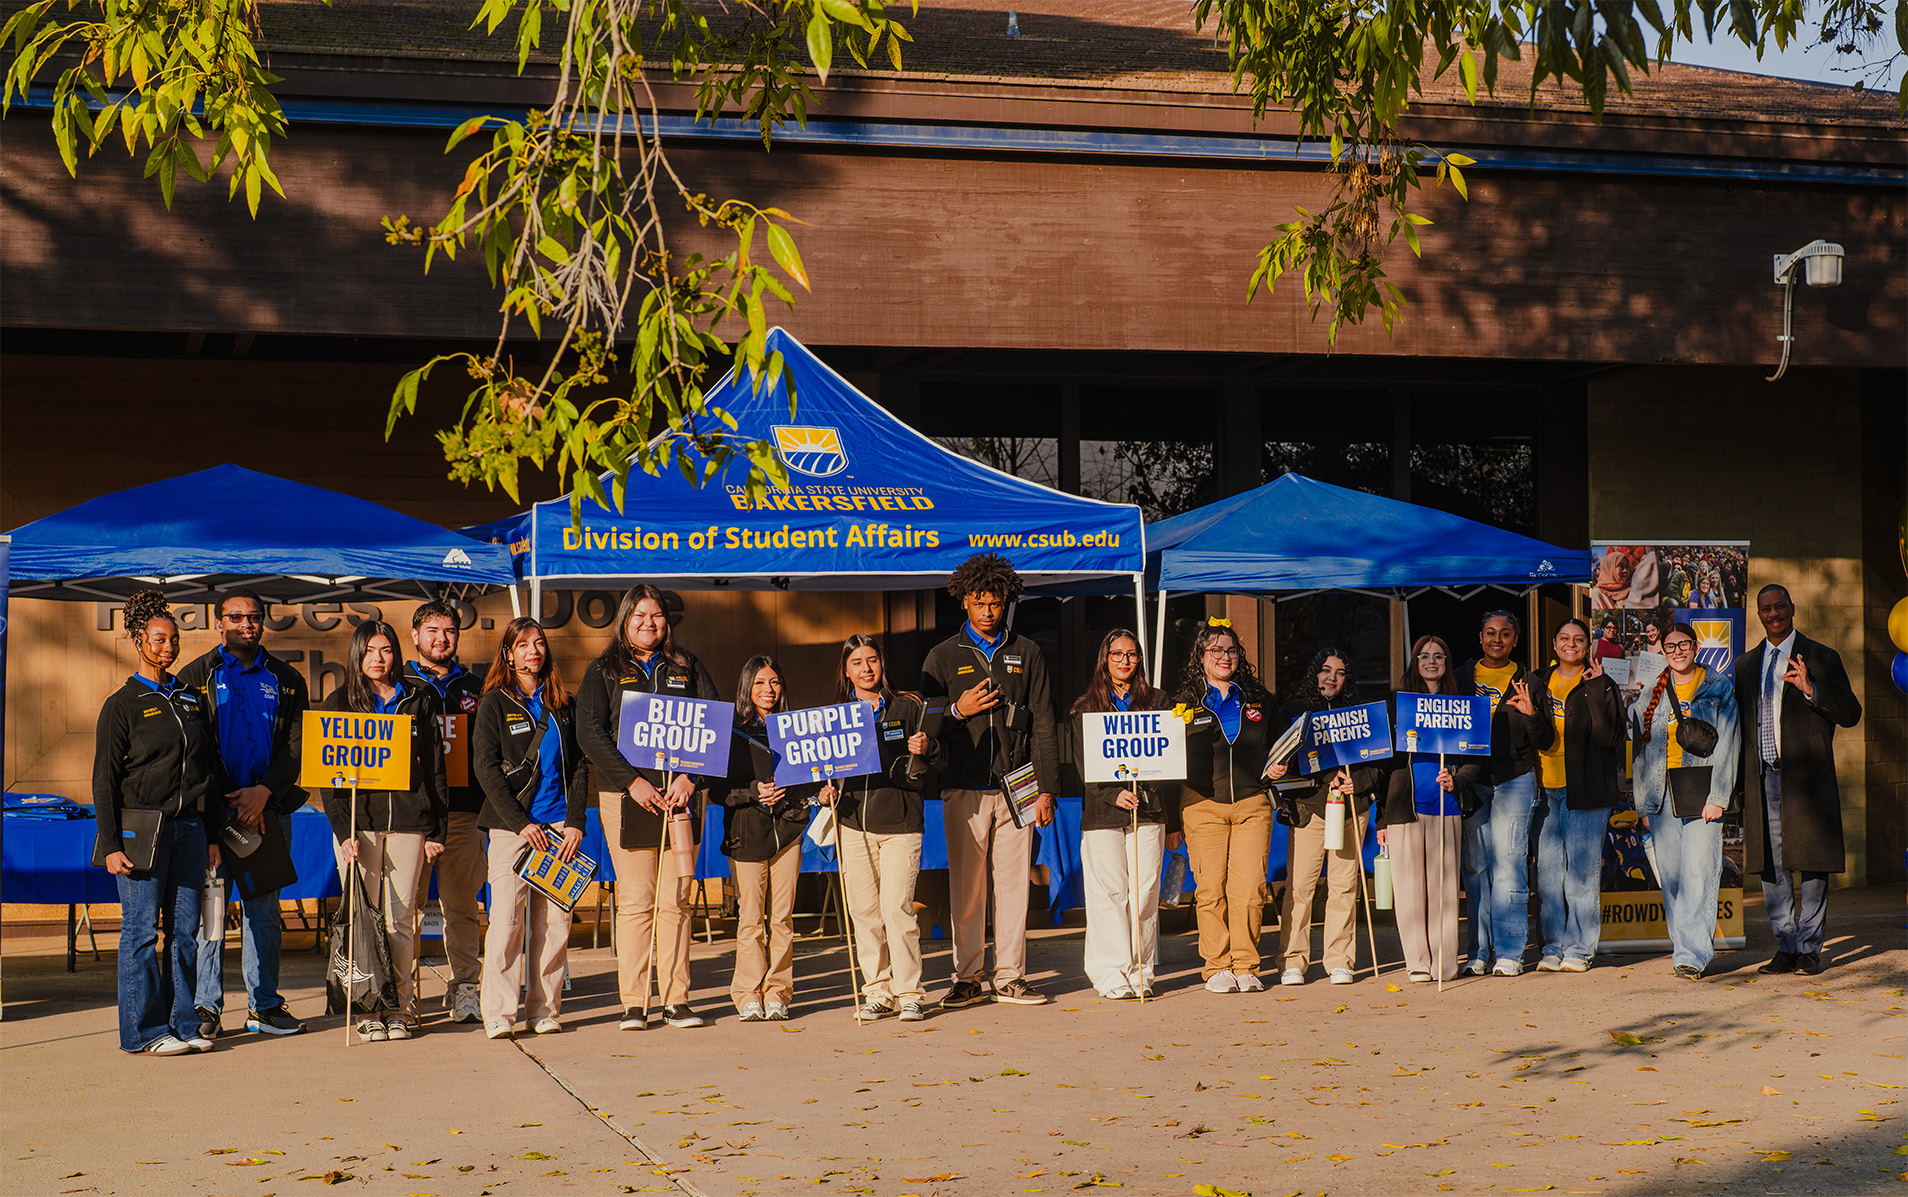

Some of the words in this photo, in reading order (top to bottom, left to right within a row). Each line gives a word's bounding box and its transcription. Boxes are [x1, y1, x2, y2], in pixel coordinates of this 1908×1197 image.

[806, 485, 847, 495] STATE
[848, 486, 924, 496] UNIVERSITY
[730, 494, 935, 511] BAKERSFIELD
[563, 526, 679, 550] Division
[688, 526, 719, 550] of
[725, 525, 838, 549] Student
[845, 524, 940, 548] Affairs
[968, 530, 1120, 548] www.csub.edu
[648, 698, 708, 728] BLUE
[1417, 697, 1471, 715] ENGLISH
[320, 717, 394, 741] YELLOW
[777, 703, 864, 739] PURPLE
[1103, 714, 1161, 735] WHITE
[1312, 708, 1369, 731] SPANISH
[1415, 712, 1472, 730] PARENTS
[633, 721, 717, 753] GROUP
[1313, 723, 1371, 746] PARENTS
[322, 744, 391, 768] GROUP
[785, 732, 862, 765] GROUP
[1102, 737, 1169, 758] GROUP
